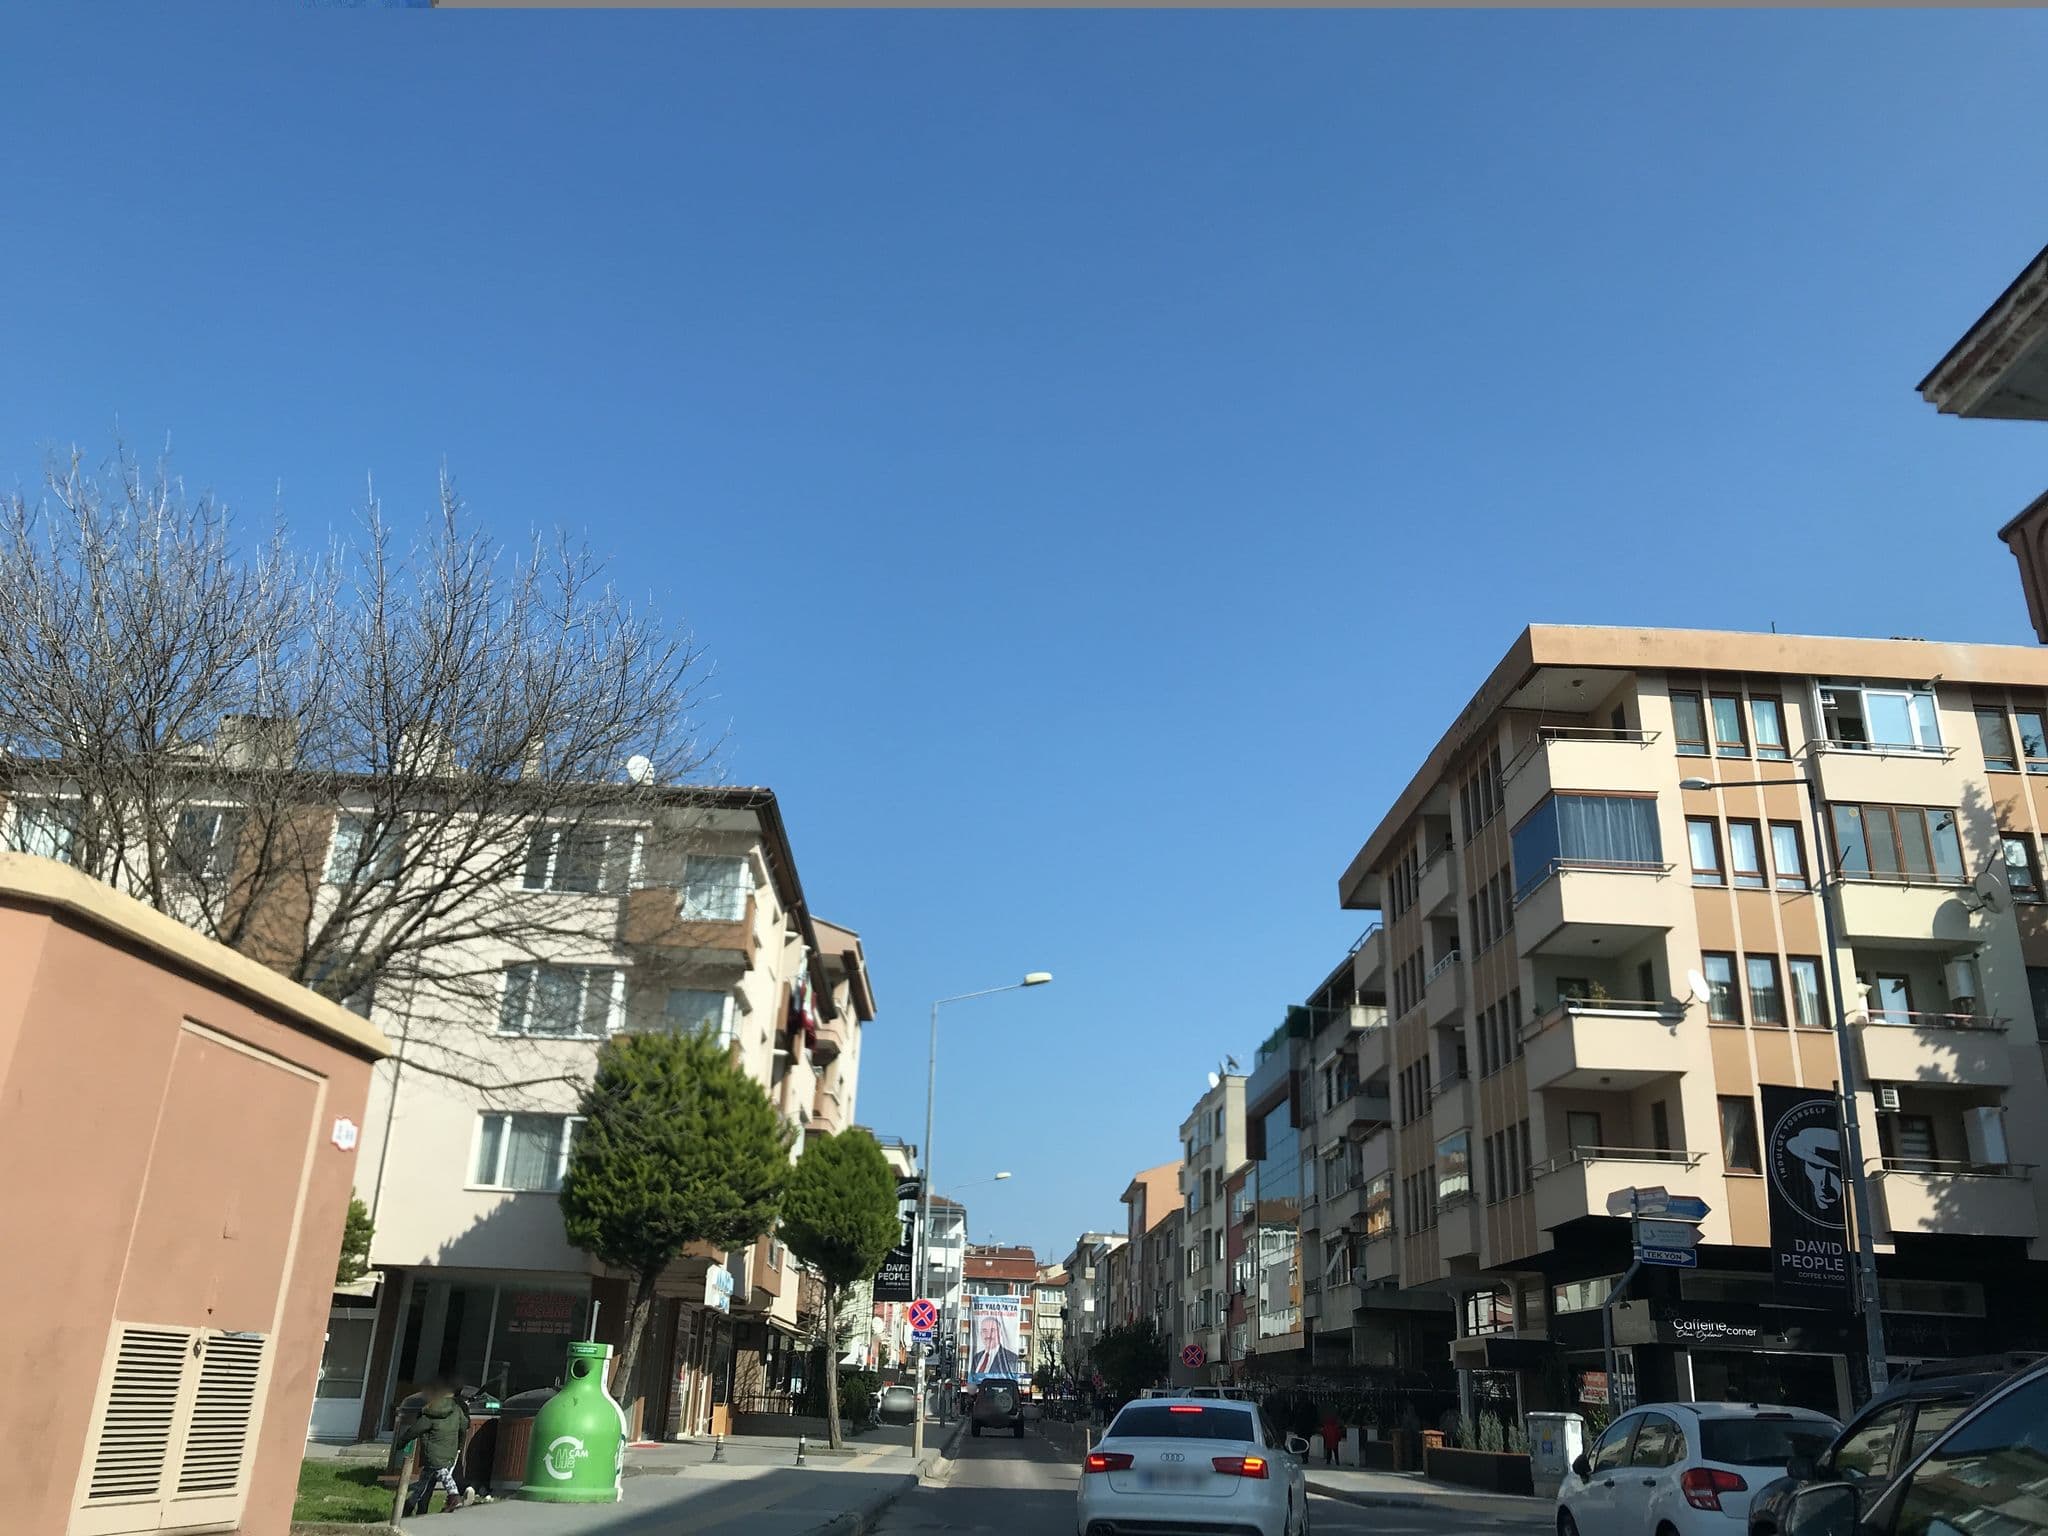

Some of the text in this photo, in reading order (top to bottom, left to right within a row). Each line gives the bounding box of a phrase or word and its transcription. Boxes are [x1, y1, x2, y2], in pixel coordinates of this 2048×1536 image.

[1795, 1239, 1843, 1255] DAVID
[886, 1263, 911, 1272] DAVID
[1781, 1253, 1845, 1272] PEOPLE
[877, 1272, 911, 1281] PEOPLE
[1673, 1318, 1757, 1337] Caffeine corner
